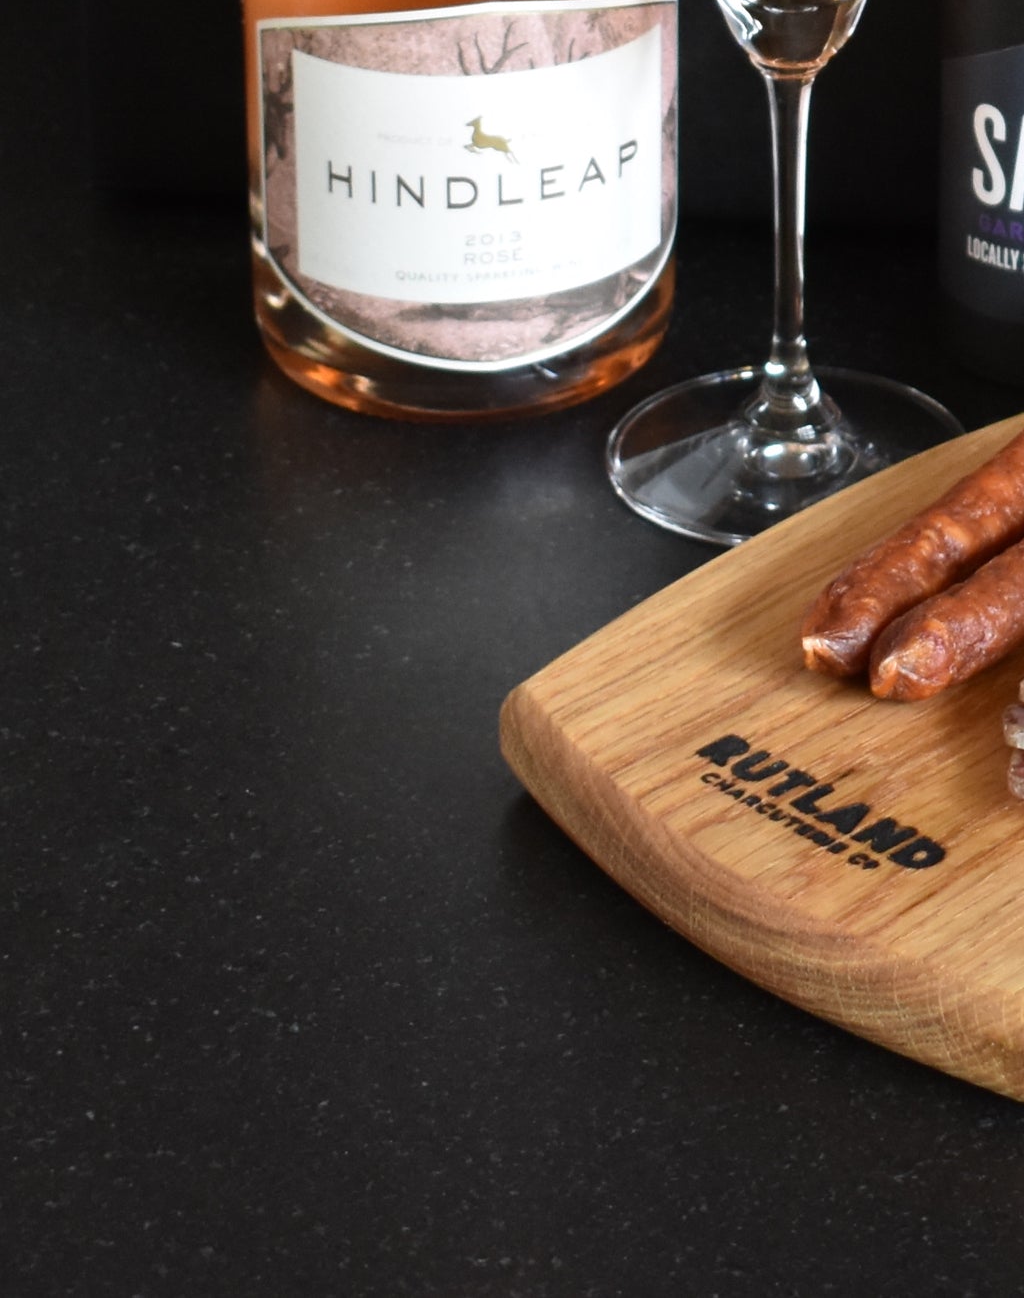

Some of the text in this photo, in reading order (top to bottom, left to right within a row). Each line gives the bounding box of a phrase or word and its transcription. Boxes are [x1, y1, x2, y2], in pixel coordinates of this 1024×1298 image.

[328, 140, 638, 210] HINDLEAP
[464, 230, 523, 247] 2013
[967, 235, 1020, 271] LOCALLY
[394, 268, 543, 284] QUALITY SPARKLIN
[694, 734, 946, 869] RUTLAND
